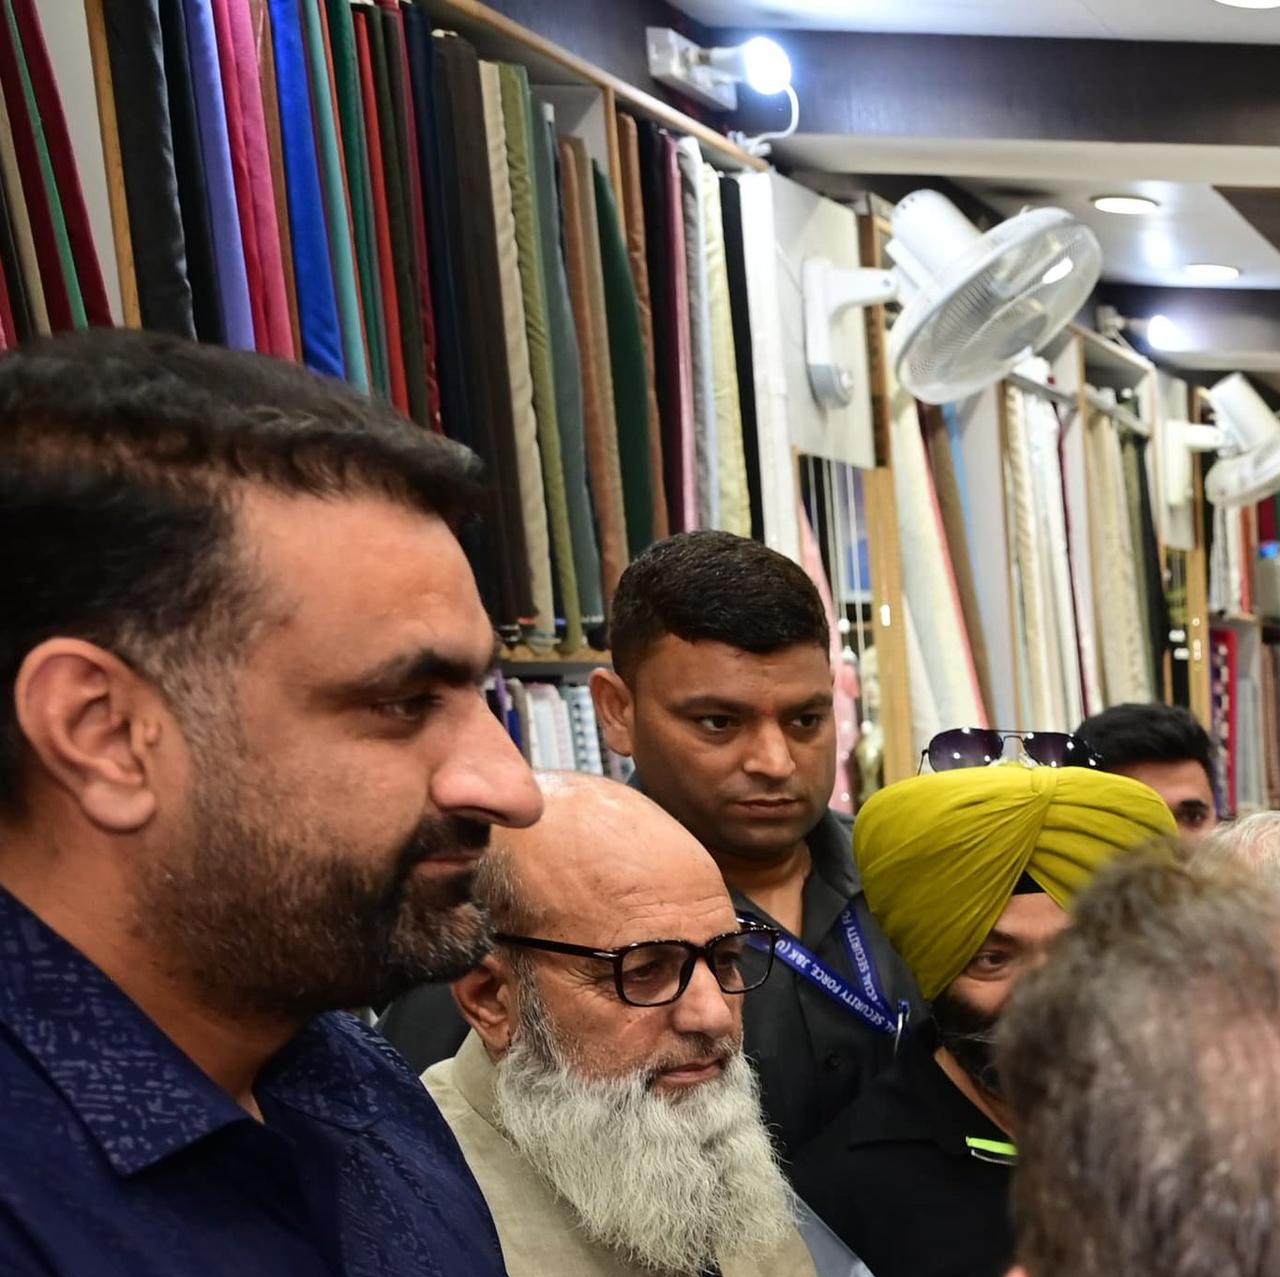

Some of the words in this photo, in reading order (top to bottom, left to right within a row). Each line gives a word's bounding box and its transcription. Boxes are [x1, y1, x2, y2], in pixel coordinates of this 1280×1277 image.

[788, 949, 812, 969] J&K
[846, 926, 869, 973] SECURITY
[810, 962, 842, 995] FORCE,
[840, 989, 885, 1026] SECURITY
